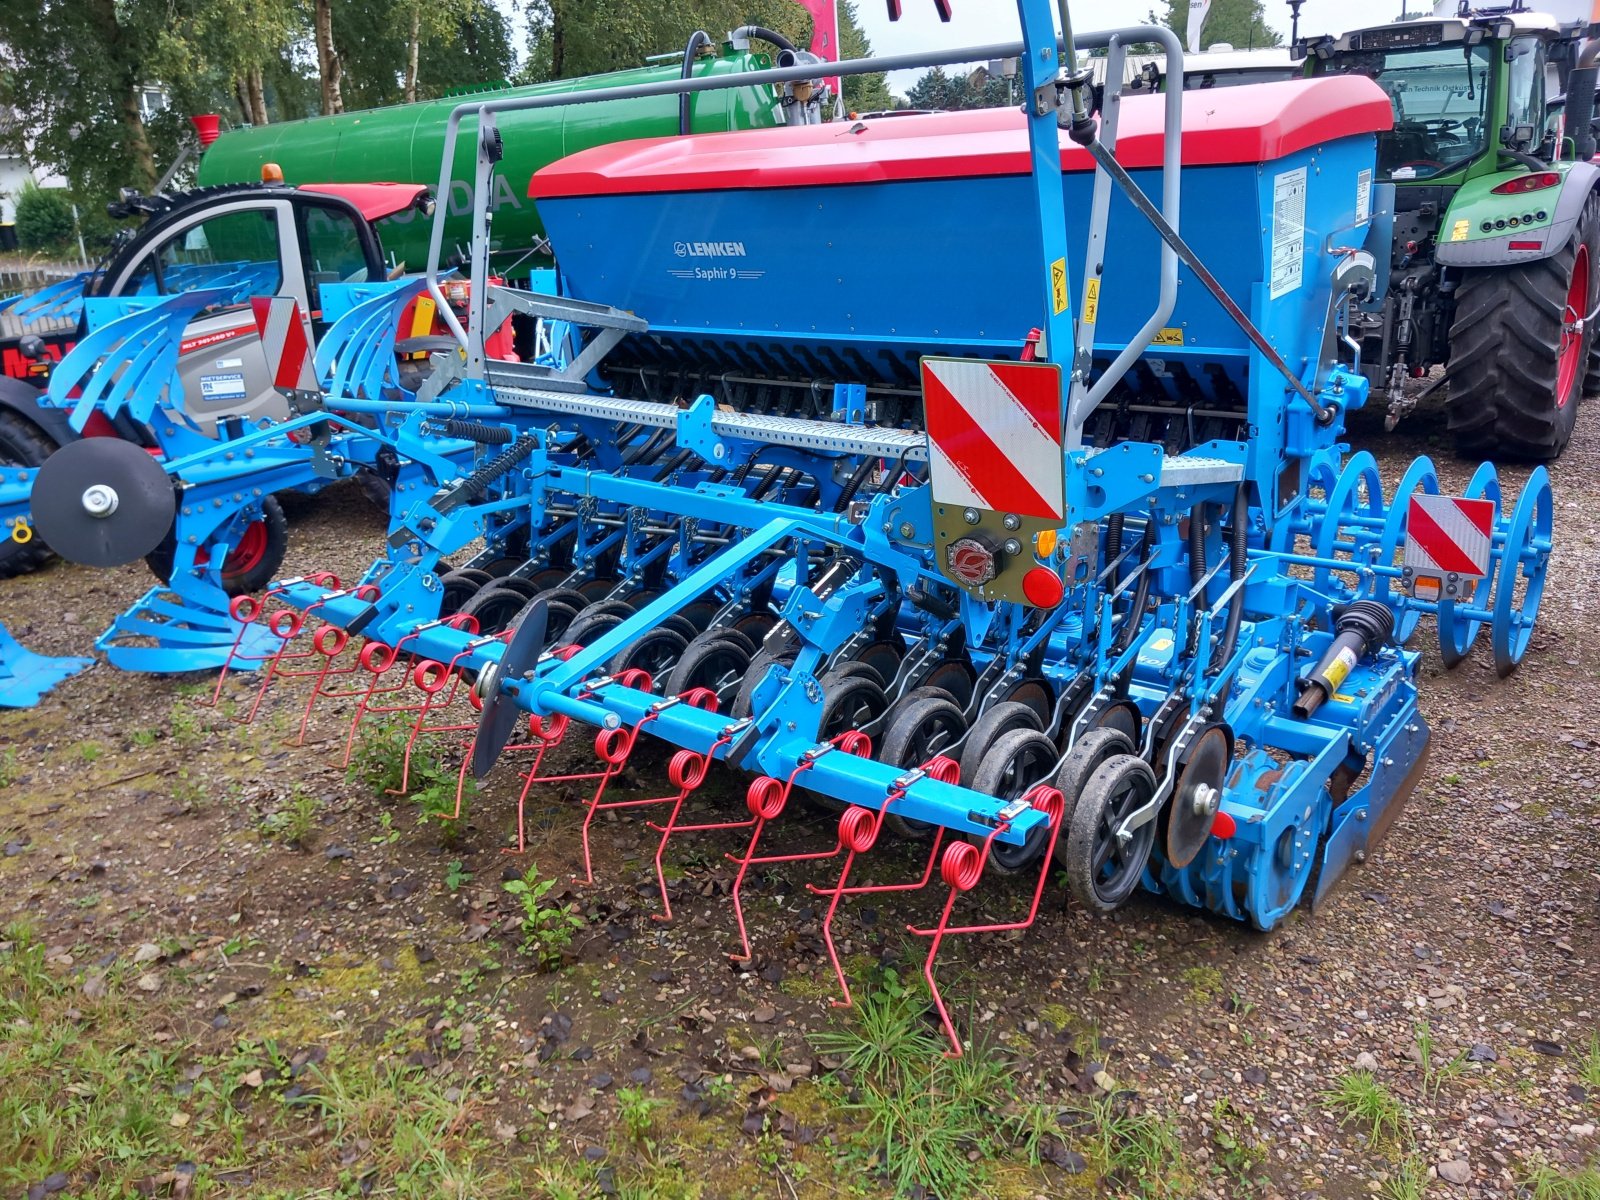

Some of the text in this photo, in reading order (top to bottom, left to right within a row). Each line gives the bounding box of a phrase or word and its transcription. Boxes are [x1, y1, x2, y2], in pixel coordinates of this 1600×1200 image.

[1442, 84, 1472, 92] Ostküst
[686, 242, 746, 259] LEMKEN
[695, 267, 736, 281] Saphir 9
